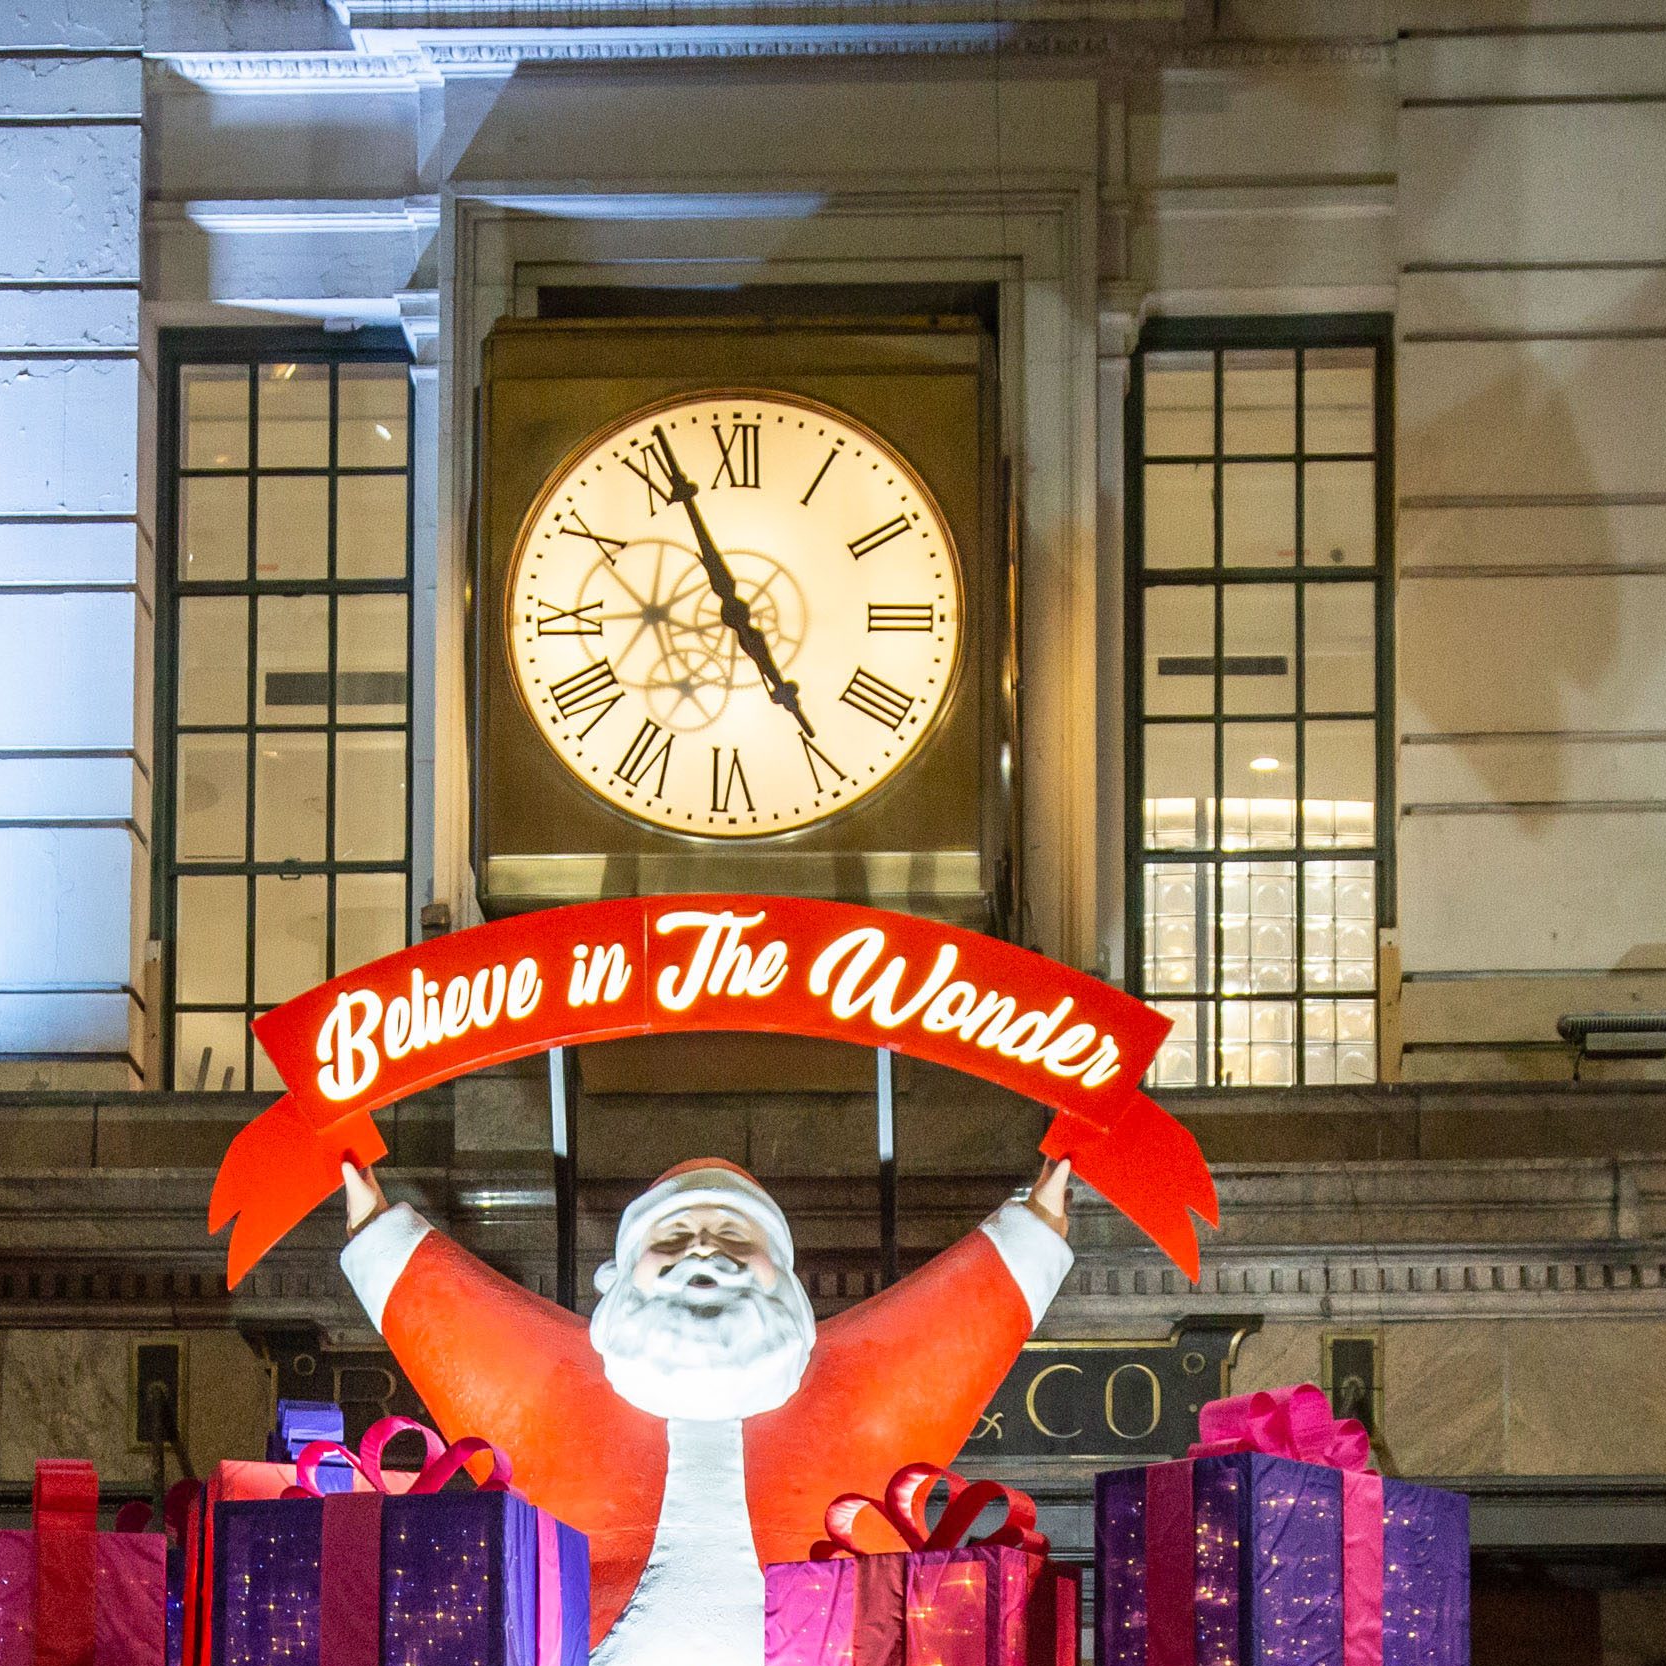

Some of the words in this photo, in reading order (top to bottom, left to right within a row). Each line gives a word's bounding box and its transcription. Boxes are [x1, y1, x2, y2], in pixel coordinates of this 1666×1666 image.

[711, 423, 761, 490] XII
[560, 510, 628, 566] X
[867, 602, 934, 633] III
[316, 953, 542, 1103] Believe
[568, 940, 633, 1008] in
[654, 910, 789, 1013] The
[807, 926, 1121, 1089] Wonder
